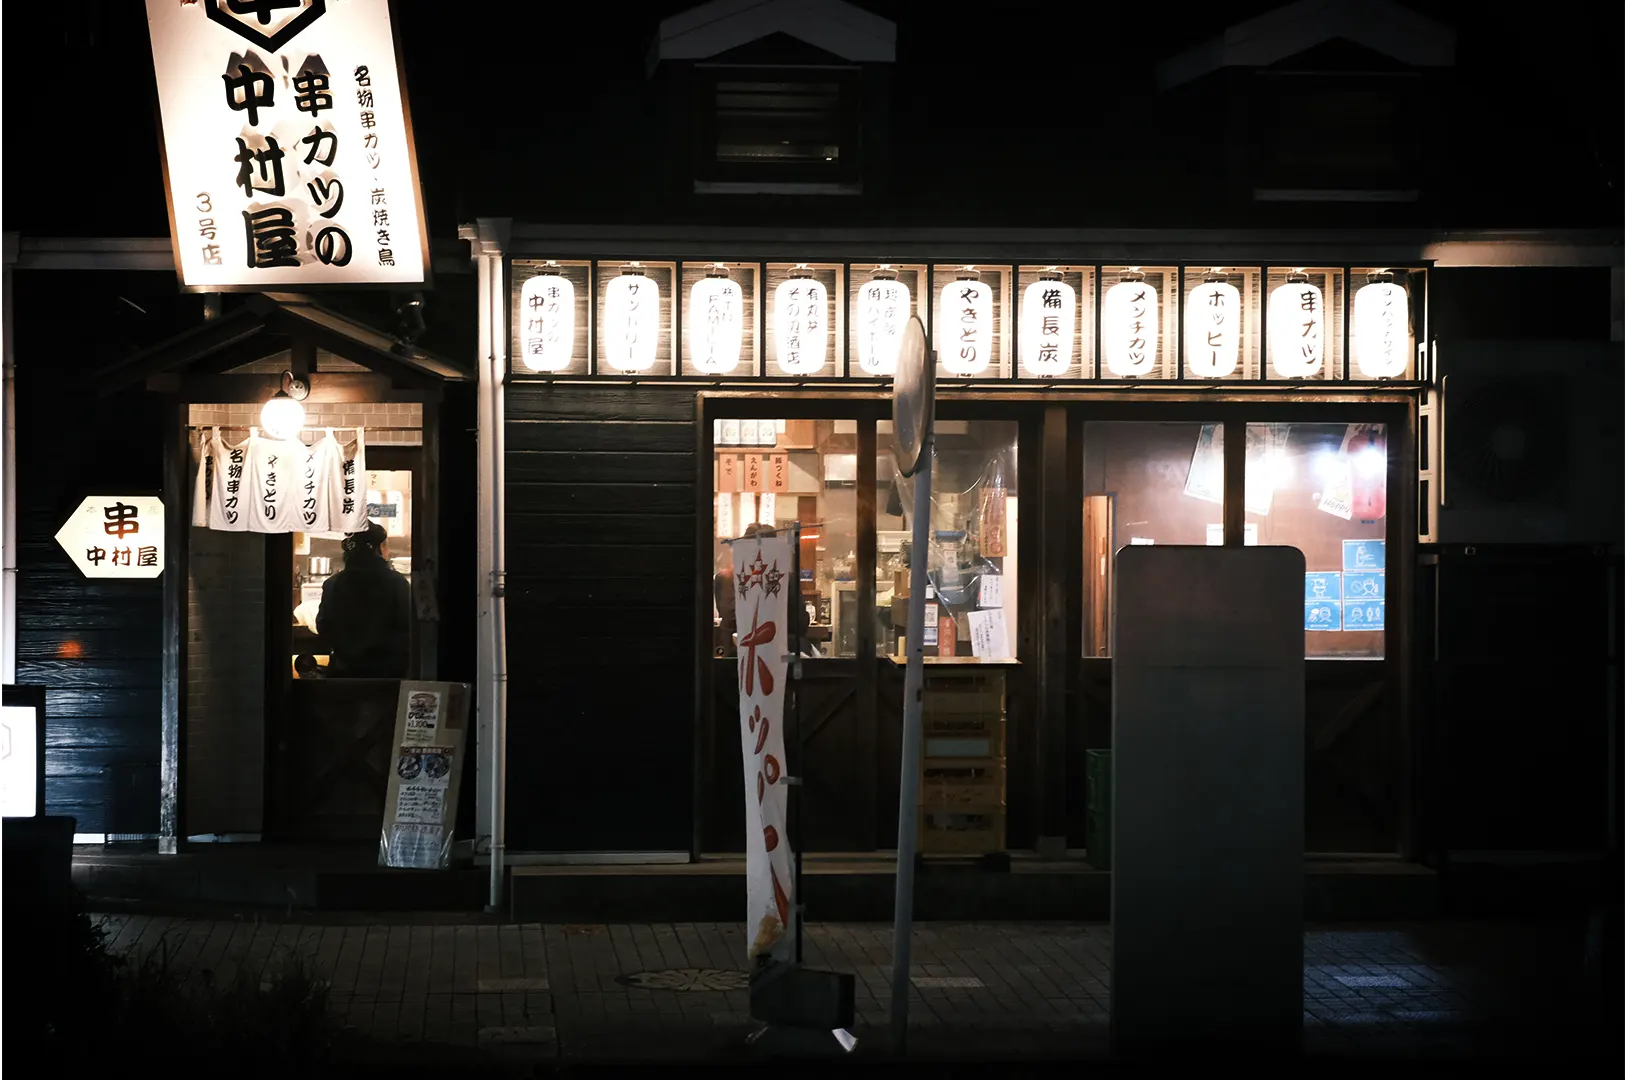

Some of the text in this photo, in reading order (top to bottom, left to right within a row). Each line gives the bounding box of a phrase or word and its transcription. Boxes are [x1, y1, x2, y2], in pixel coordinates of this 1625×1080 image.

[222, 64, 301, 268] 中村屋
[292, 71, 353, 267] 串カツの
[196, 191, 223, 265] 3号店
[527, 294, 545, 355] 中村屋
[625, 283, 640, 359] サントリー
[959, 287, 979, 362] やきとり
[1037, 288, 1063, 363] 備長炭
[1128, 290, 1146, 366] メンチカツ
[225, 448, 244, 525] 名物串カツ
[263, 454, 279, 521] やきとり
[302, 452, 317, 526] メンチカツ
[341, 459, 356, 515] 備長炭
[750, 456, 758, 487] えんがわ
[85, 545, 158, 567] 中村屋
[103, 501, 140, 540] 串
